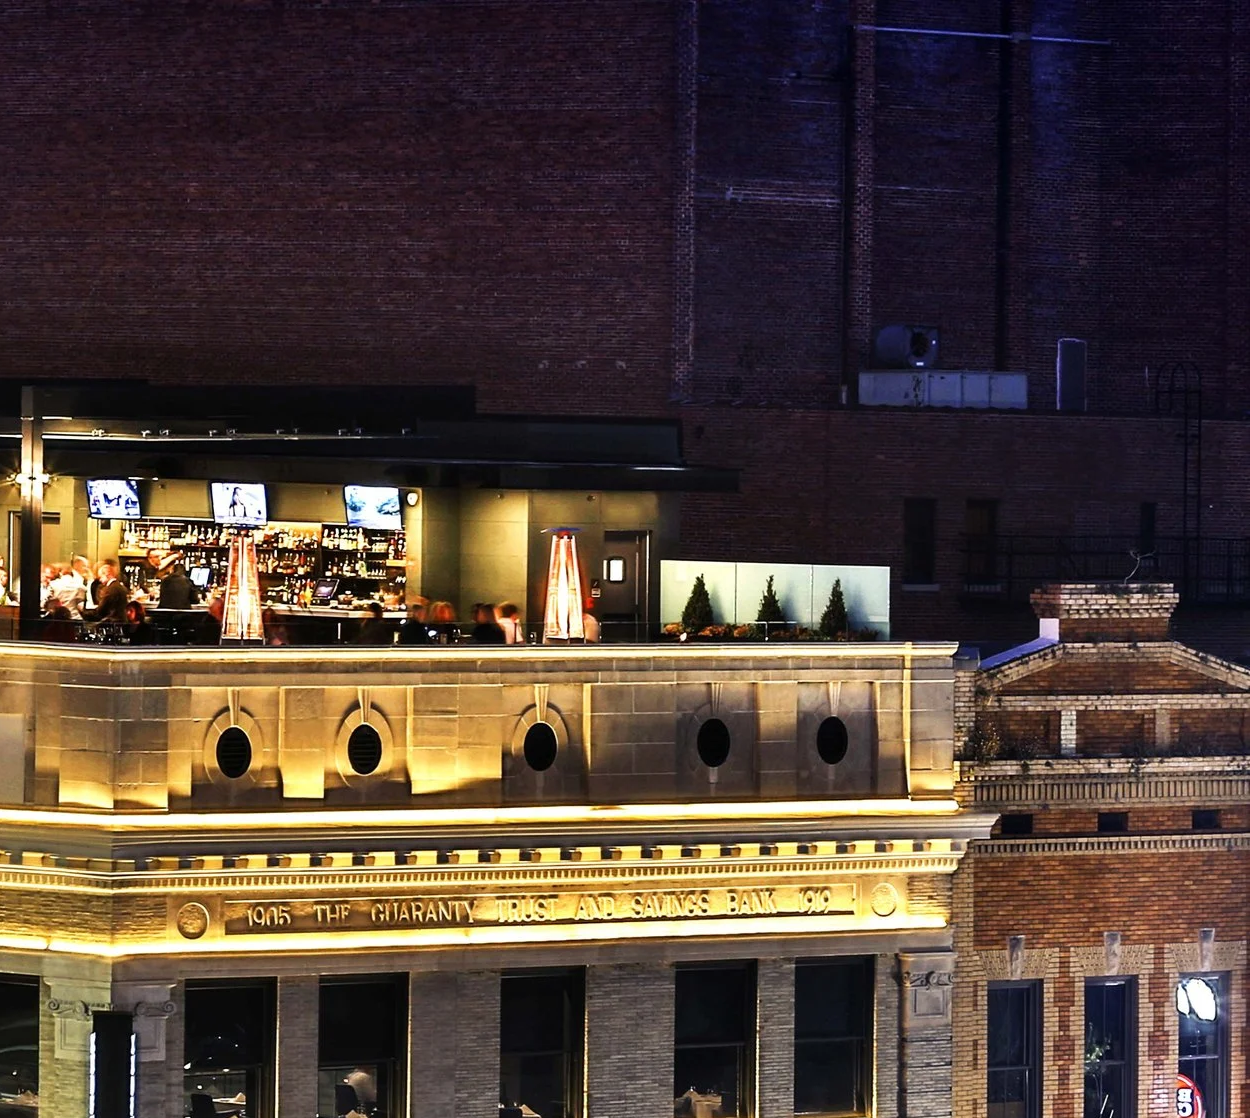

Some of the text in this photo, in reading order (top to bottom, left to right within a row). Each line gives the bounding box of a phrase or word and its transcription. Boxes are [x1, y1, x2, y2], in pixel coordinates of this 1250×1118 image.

[313, 903, 351, 923] THE
[370, 900, 477, 923] GUARANTY
[495, 895, 558, 922] TRUST
[574, 895, 616, 920] AND
[631, 892, 710, 919] SAVINGS
[726, 890, 778, 915] BANK
[798, 889, 831, 914] 1919
